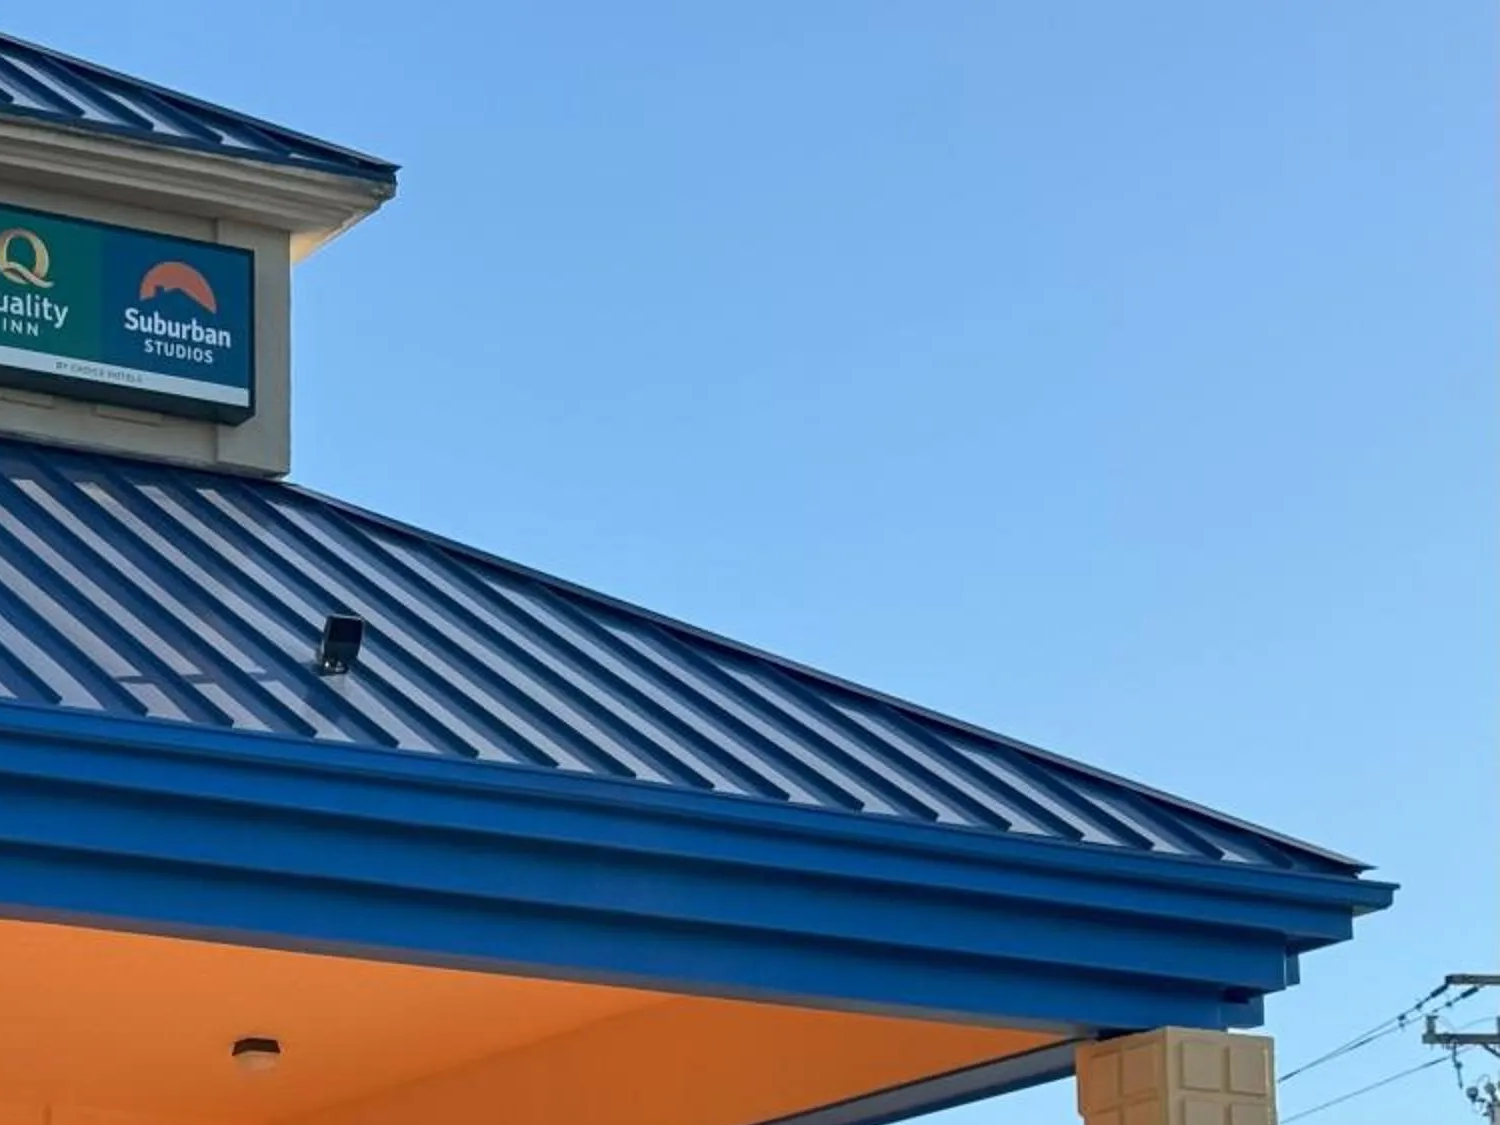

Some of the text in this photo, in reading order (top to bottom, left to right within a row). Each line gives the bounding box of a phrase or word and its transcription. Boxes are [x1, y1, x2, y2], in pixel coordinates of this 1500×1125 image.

[3, 317, 39, 336] INN
[124, 307, 231, 348] Suburban
[144, 338, 213, 364] STUDIOS
